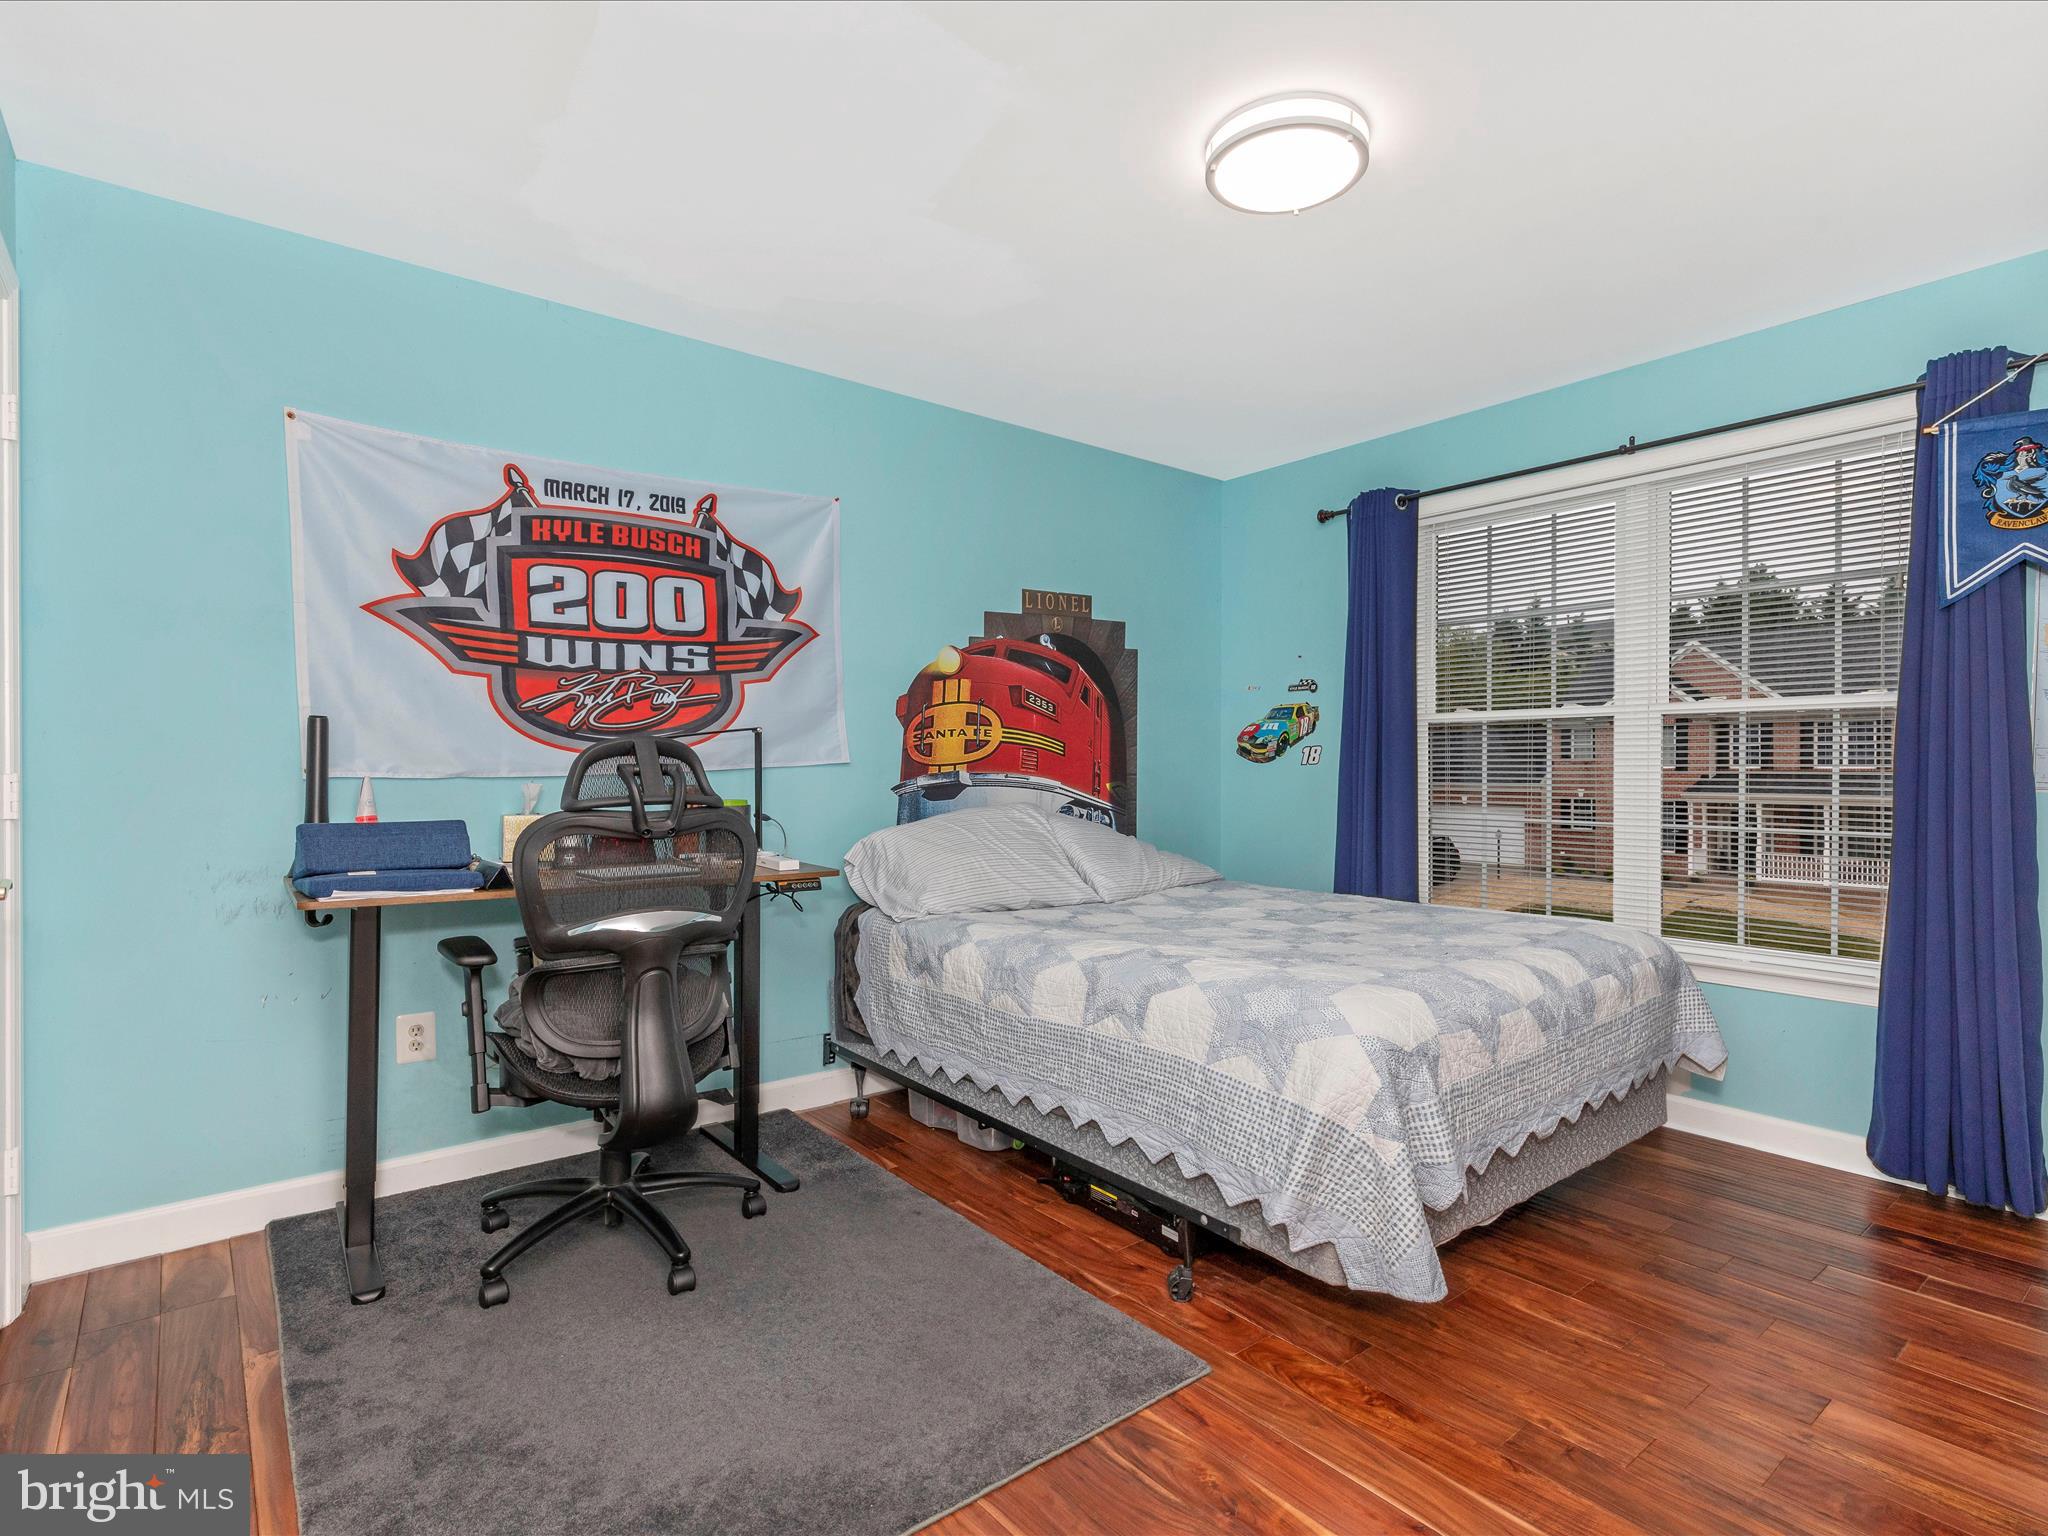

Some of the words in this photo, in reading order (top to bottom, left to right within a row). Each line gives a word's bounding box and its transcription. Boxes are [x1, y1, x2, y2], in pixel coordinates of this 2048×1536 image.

[544, 478, 610, 505] MARCH
[618, 489, 642, 512] 17,
[649, 493, 687, 515] 2019
[531, 518, 605, 544] KYLE
[611, 524, 702, 559] BUSCH
[528, 563, 706, 636] 200
[1024, 591, 1089, 613] LIONEL
[525, 635, 710, 673] WINS
[1028, 694, 1054, 712] 2353
[913, 728, 967, 743] SANTA
[973, 728, 992, 738] FE
[1301, 745, 1321, 765] 18
